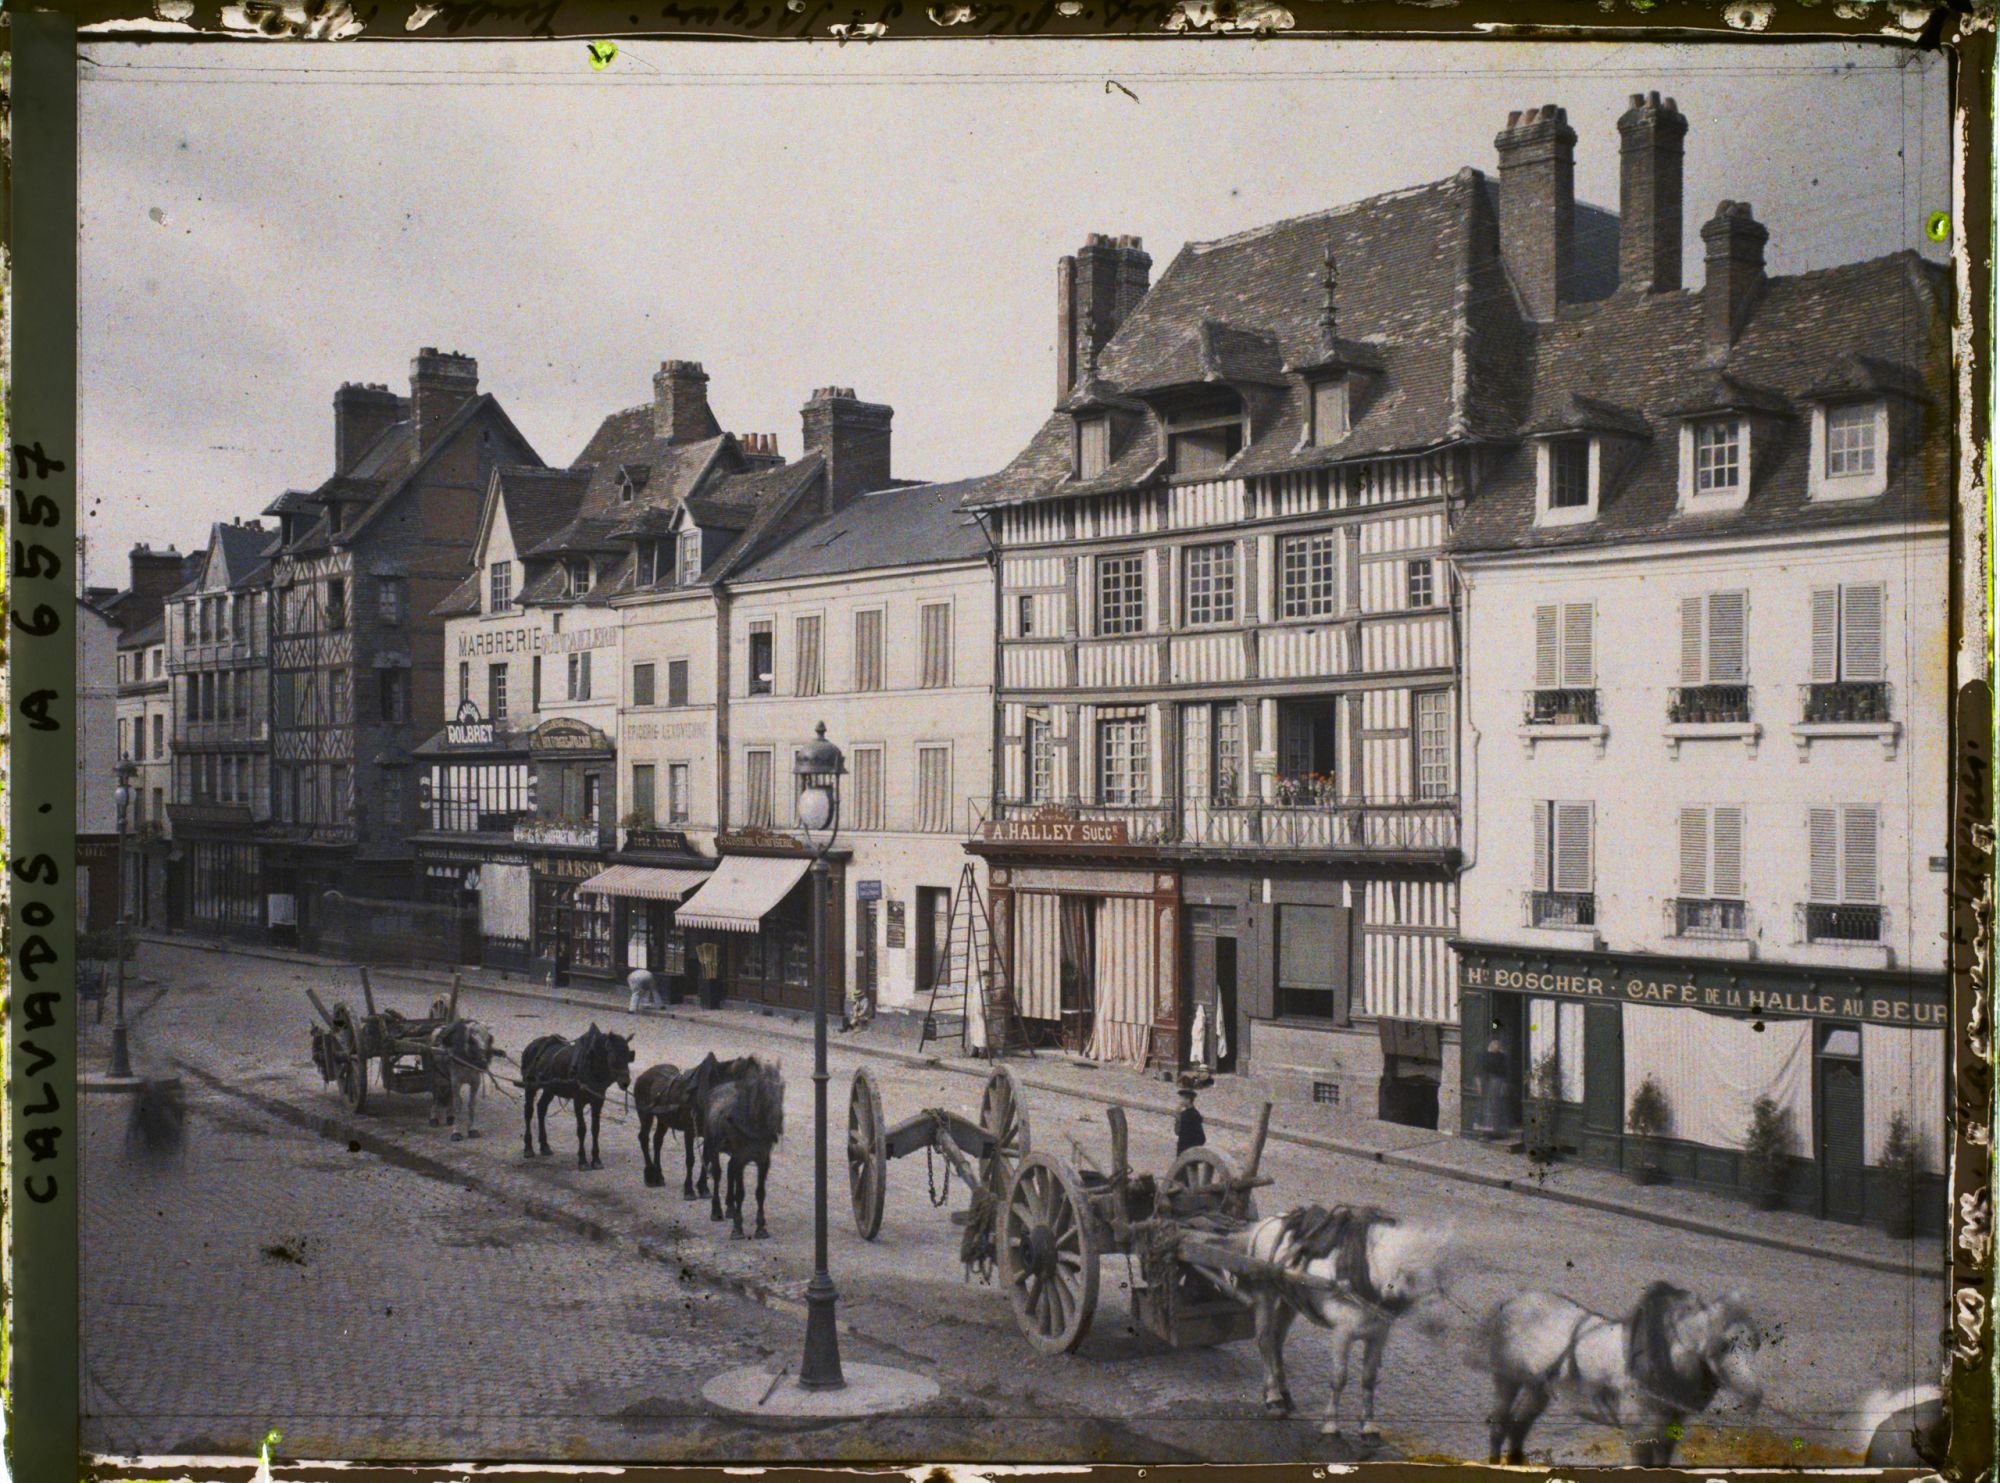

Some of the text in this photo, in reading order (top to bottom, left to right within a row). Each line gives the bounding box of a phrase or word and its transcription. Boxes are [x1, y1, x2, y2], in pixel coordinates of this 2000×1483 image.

[459, 627, 542, 657] MARBRERIE
[11, 441, 65, 1204] CALVADOS A 6557
[1495, 969, 1604, 995] BOSCHER
[1705, 988, 1721, 1005] DE
[1727, 990, 1741, 1007] LA
[1749, 989, 1837, 1014] HALLE
[1842, 998, 1864, 1017] AU
